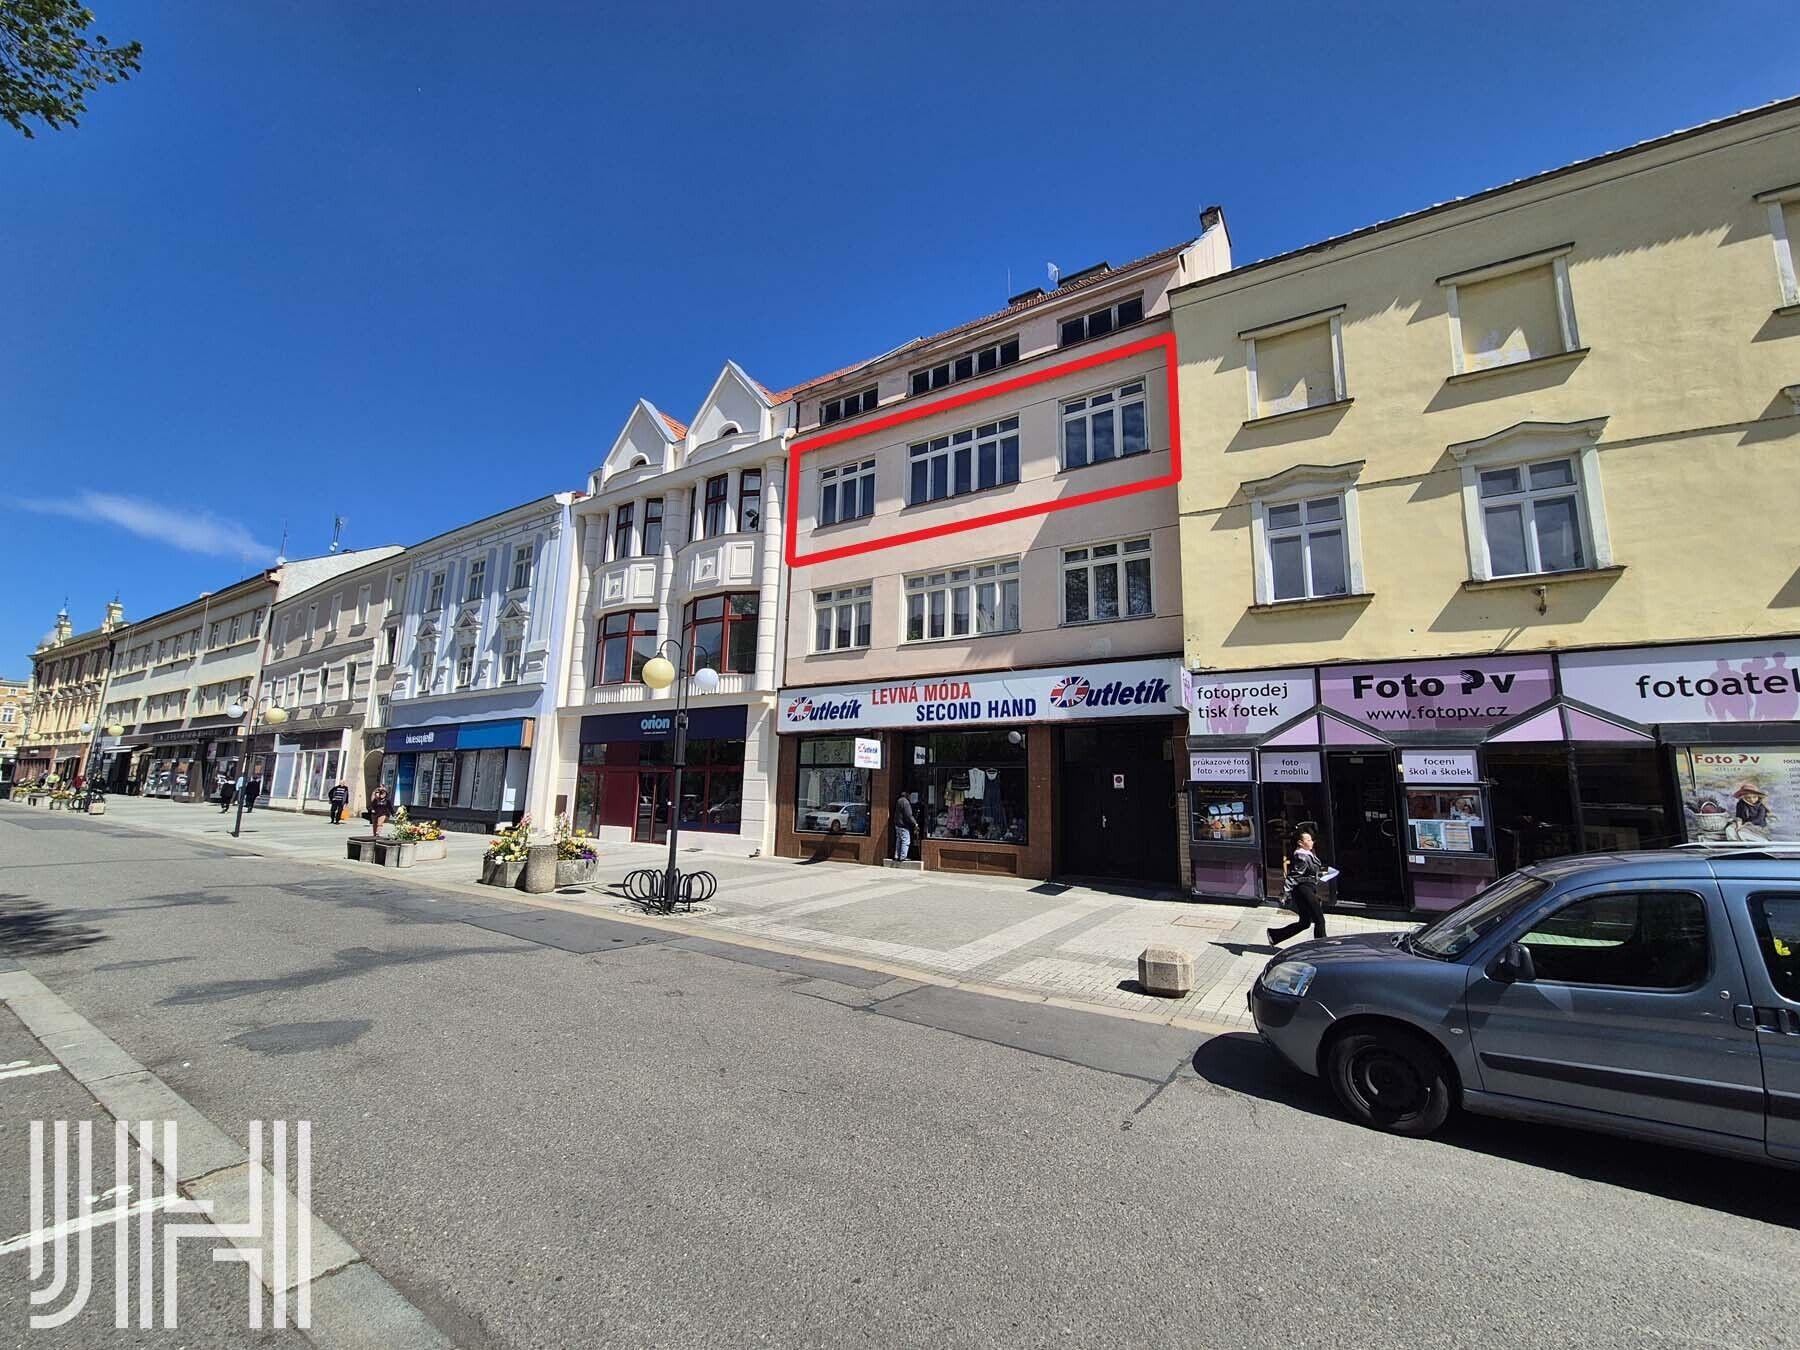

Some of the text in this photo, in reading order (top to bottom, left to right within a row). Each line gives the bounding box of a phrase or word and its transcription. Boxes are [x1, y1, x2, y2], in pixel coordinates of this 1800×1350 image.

[1352, 674, 1445, 700] Foto
[1635, 668, 1800, 699] fotoatel
[872, 679, 972, 705] LEVNÁ MÓDA
[1197, 682, 1288, 701] fotoprodej
[916, 698, 1036, 722] SECOND HAND
[1198, 703, 1279, 718] tisk fotek
[1366, 705, 1508, 721] www.fotopv.cz
[641, 714, 670, 729] orion
[1233, 759, 1250, 767] foto
[1282, 759, 1299, 767] foto
[1695, 754, 1733, 764] Foto
[1197, 767, 1213, 775] foto
[1220, 767, 1246, 776] expres
[1281, 767, 1309, 775] mobilu
[1409, 767, 1429, 776] škol
[1440, 767, 1473, 776] školek
